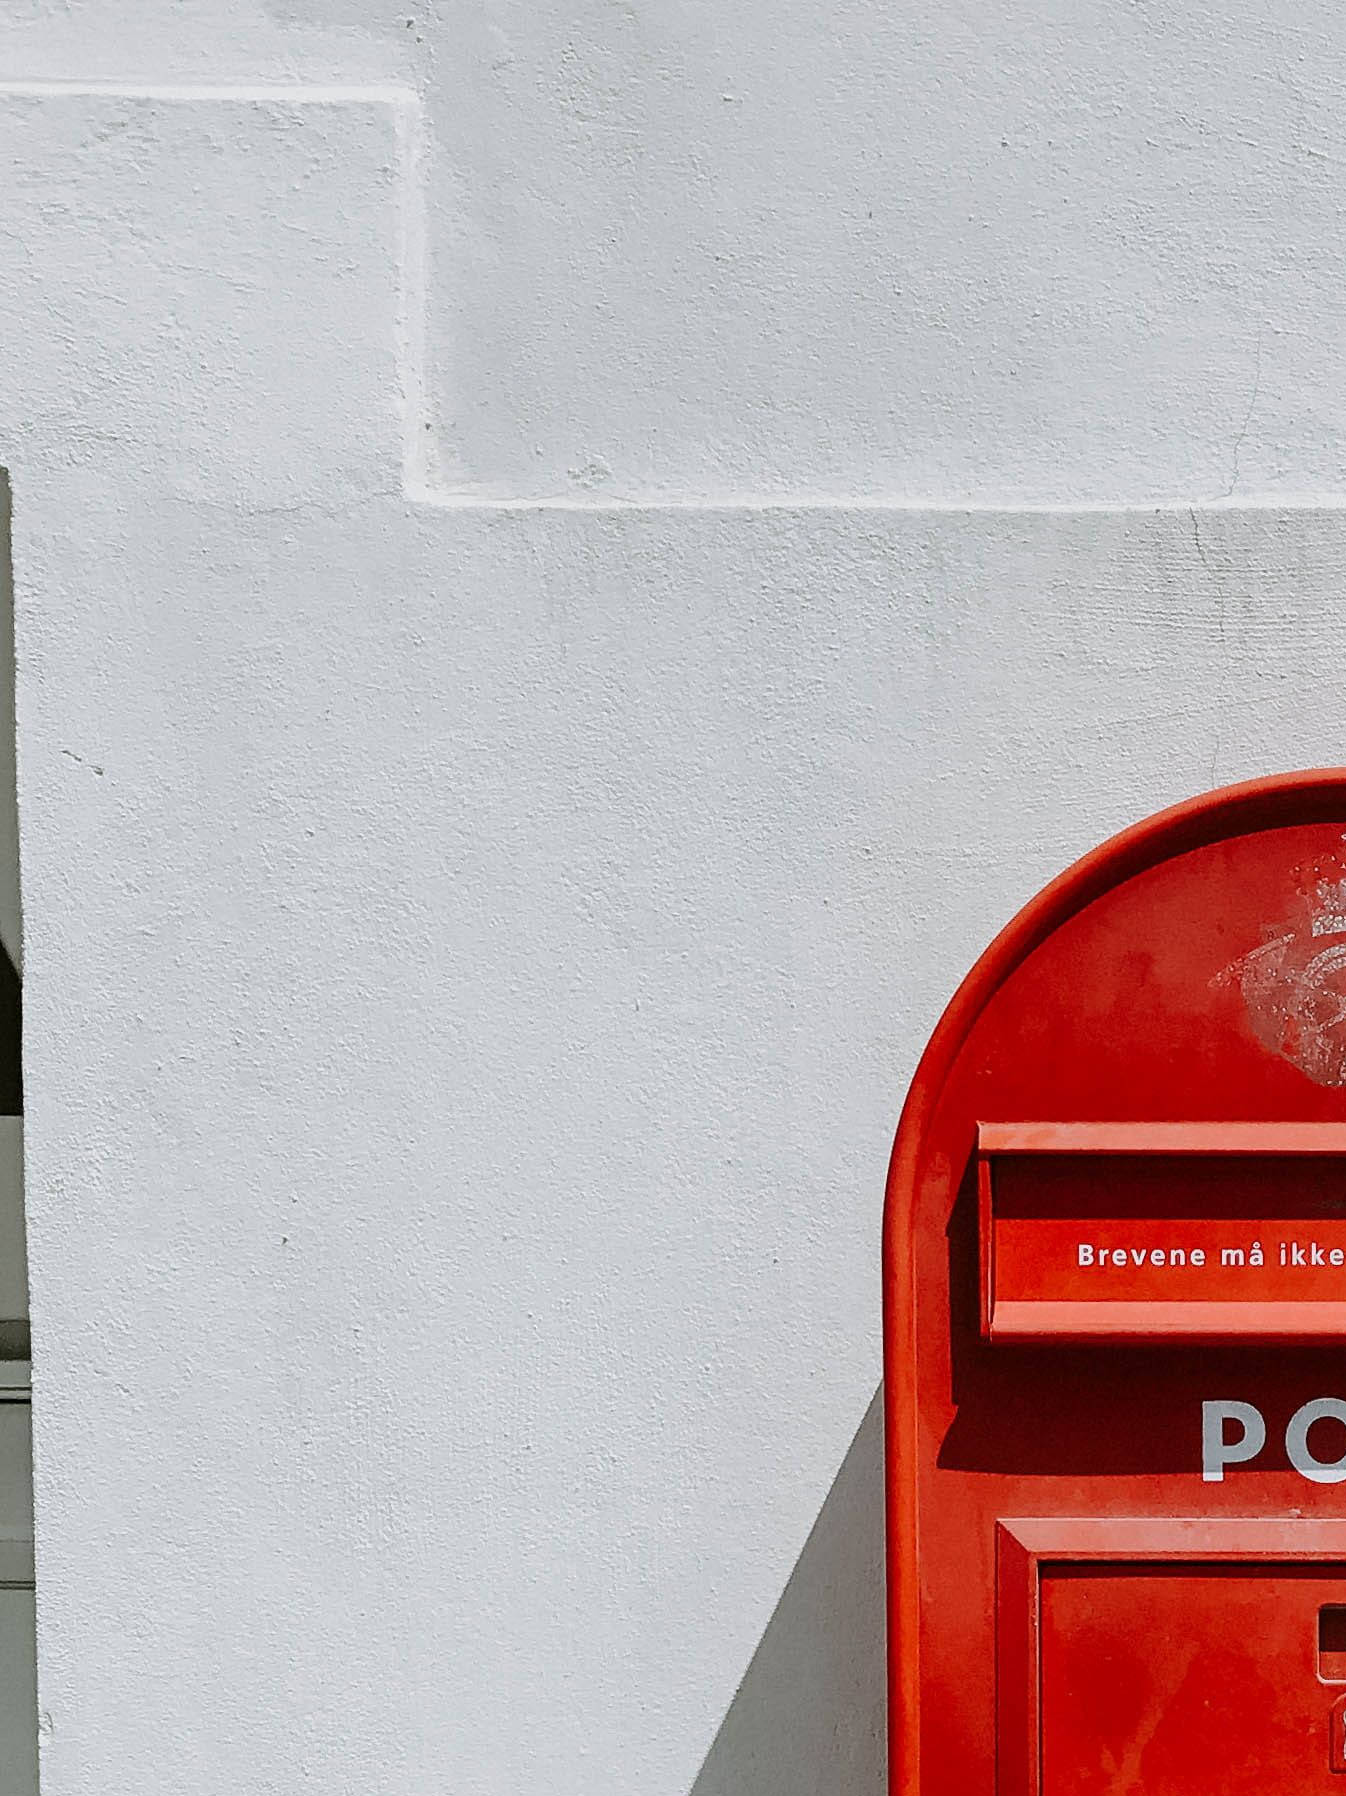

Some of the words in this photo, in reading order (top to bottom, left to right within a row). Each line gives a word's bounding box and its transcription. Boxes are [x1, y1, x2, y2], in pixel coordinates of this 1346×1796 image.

[1079, 1245, 1205, 1265] Brevene
[1222, 1242, 1263, 1265] må
[1281, 1243, 1344, 1265] ikke
